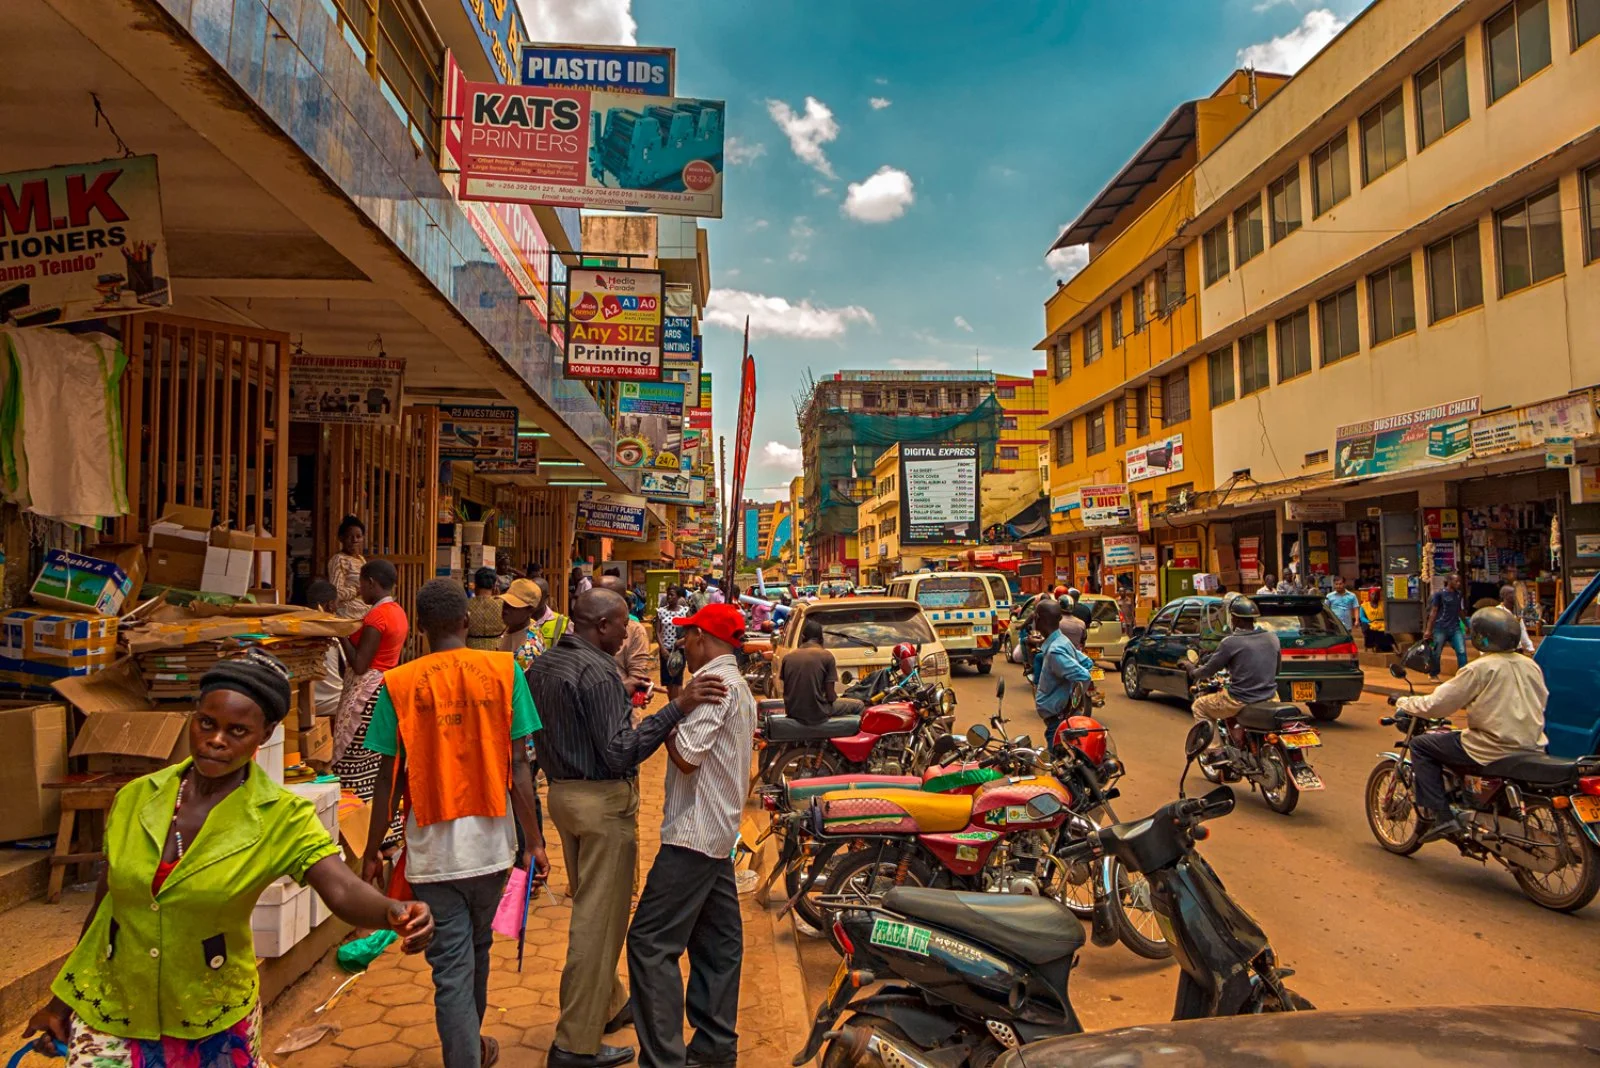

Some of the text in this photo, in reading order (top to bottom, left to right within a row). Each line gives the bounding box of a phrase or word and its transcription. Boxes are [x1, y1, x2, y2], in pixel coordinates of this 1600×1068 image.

[528, 57, 664, 84] PLASTIC IDs
[473, 93, 580, 130] KATS
[471, 129, 578, 153] PRINTERS
[608, 276, 635, 285] Media
[604, 298, 656, 318] A2 A1 A0
[664, 318, 690, 327] PLASTIC
[572, 324, 655, 343] Any SIZE
[664, 330, 681, 338] ARDS
[664, 342, 690, 352] RINTING
[574, 345, 651, 366] Printing
[338, 358, 387, 369] INVESTMENTS
[388, 359, 400, 370] LTD
[463, 409, 515, 418] INVESTMENTS
[1374, 414, 1412, 431] DUSTLESS
[1414, 407, 1446, 423] SCHOOL
[1448, 399, 1477, 415] CHALK
[520, 442, 533, 451] ERS
[904, 447, 975, 456] DIGITAL EXPRESS
[658, 456, 676, 466] 24/7
[1097, 496, 1122, 507] UIGT
[620, 506, 642, 515] PLASTIC
[616, 514, 635, 522] CARDS
[590, 519, 611, 528] DIGITAL
[612, 522, 640, 531] PRINTING
[56, 554, 92, 568] Double
[453, 660, 492, 700] CONTROL
[935, 937, 982, 958] MONSTER
